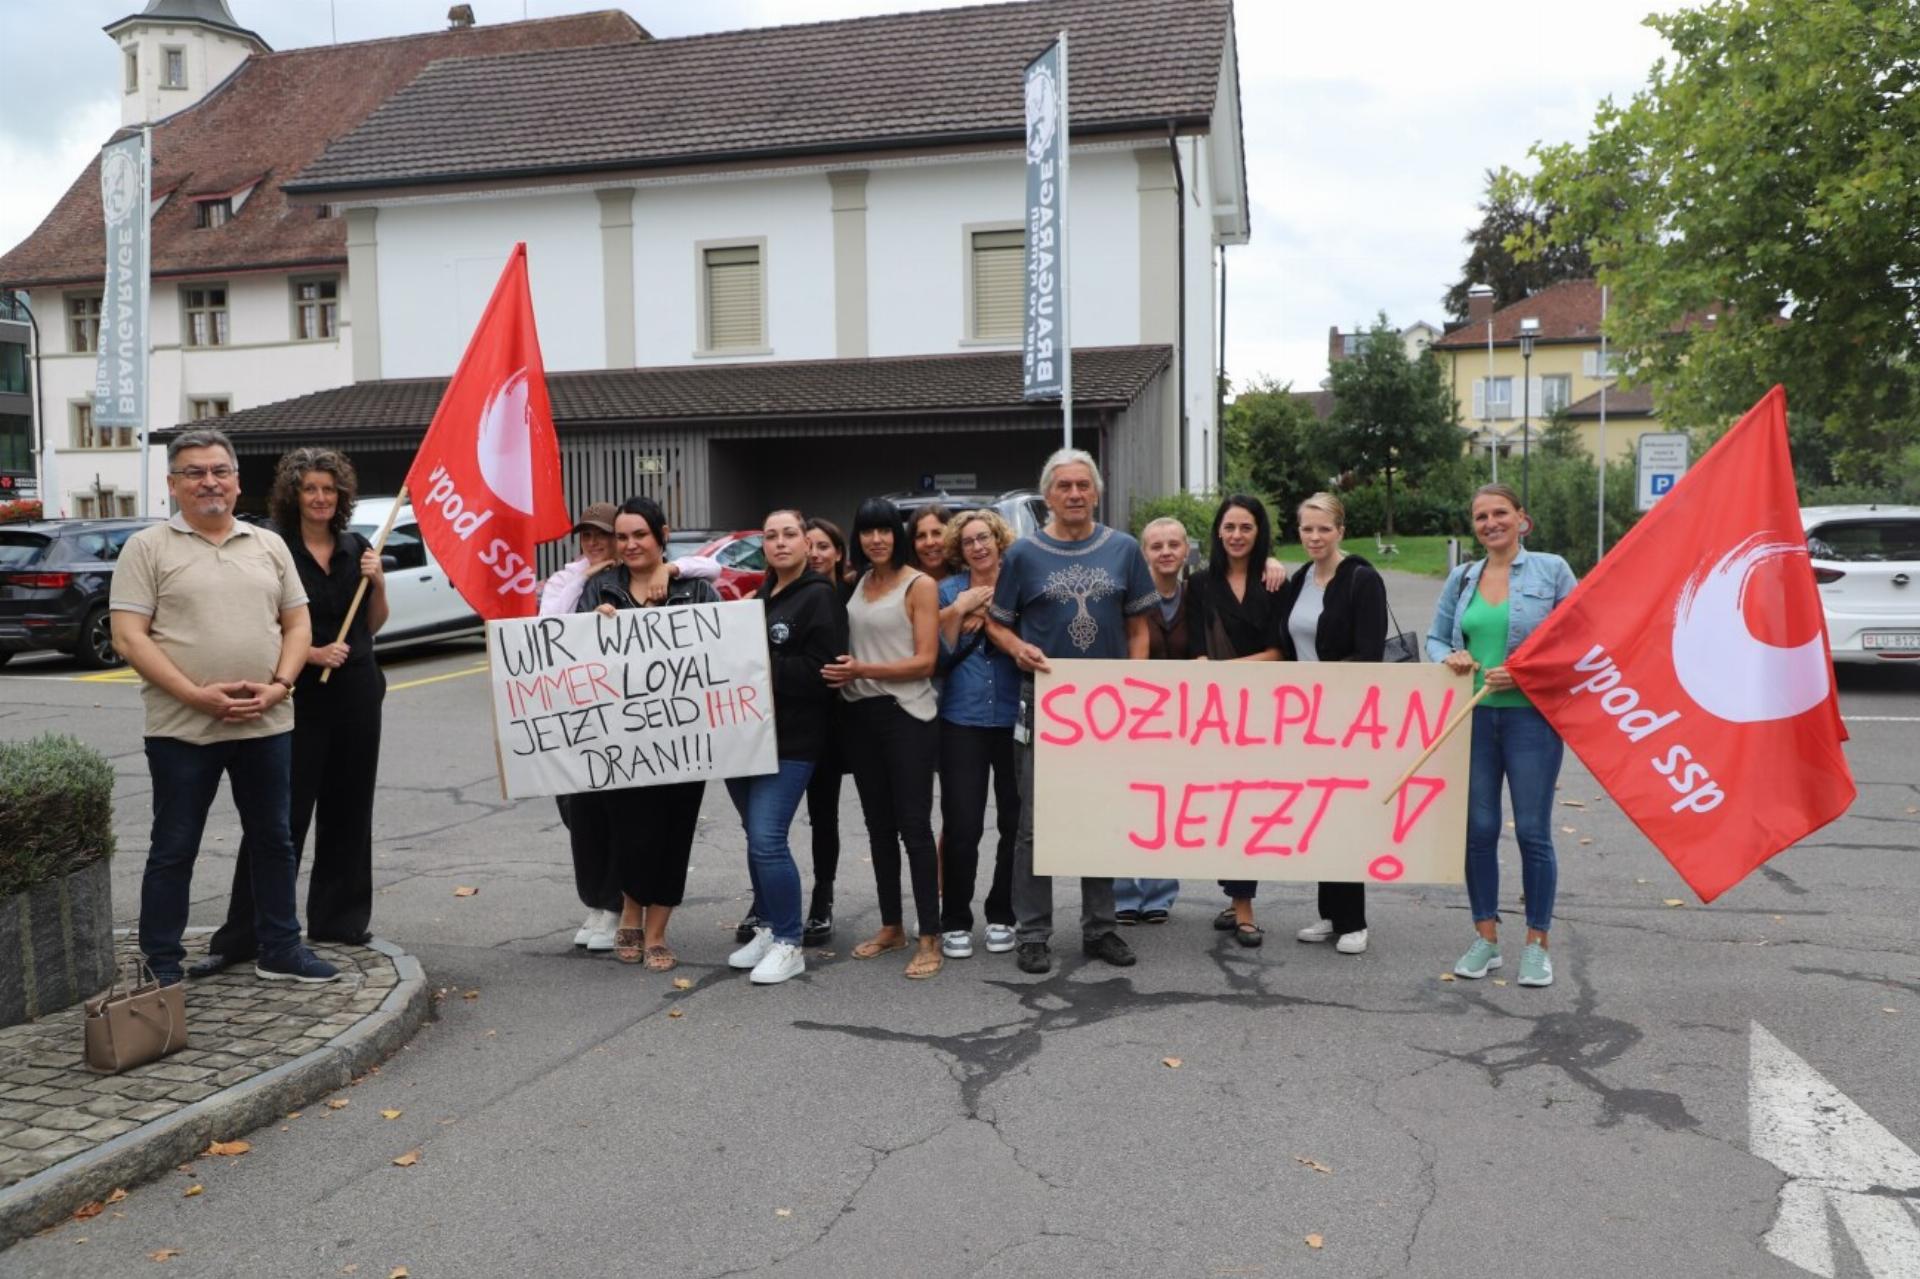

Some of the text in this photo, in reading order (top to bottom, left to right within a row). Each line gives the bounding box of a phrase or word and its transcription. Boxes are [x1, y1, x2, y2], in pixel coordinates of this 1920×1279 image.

[424, 464, 536, 595] vpod ssp
[500, 607, 721, 676] WIR WAREN
[506, 653, 730, 717] IMMER LOYAL
[510, 685, 764, 756] JETZT SEID IHR
[1040, 677, 1454, 750] SOZIALPLAN
[580, 733, 713, 789] DRAN!!!
[1569, 644, 1725, 813] vpod ssp
